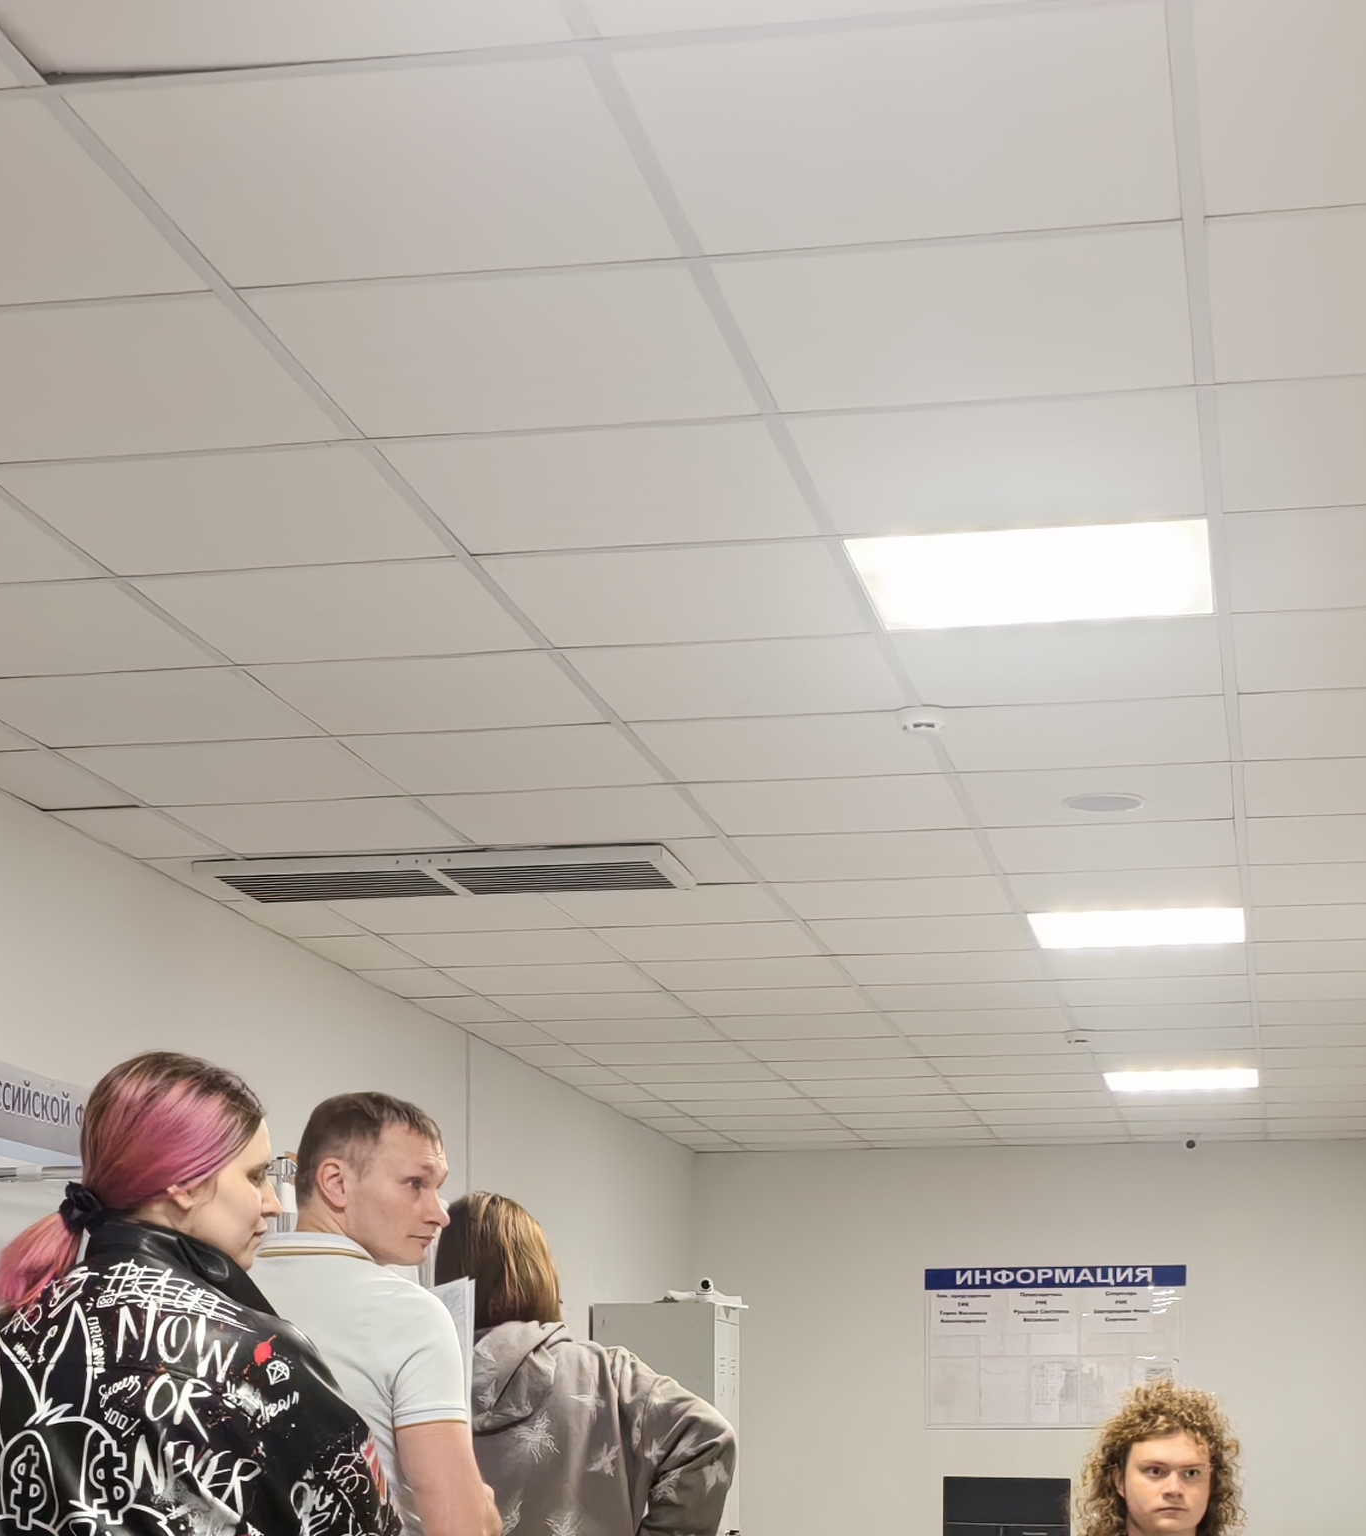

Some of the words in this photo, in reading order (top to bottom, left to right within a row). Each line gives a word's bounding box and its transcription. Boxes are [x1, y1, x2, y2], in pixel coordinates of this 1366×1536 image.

[955, 1267, 1153, 1286] ИНФОРМАЦИЯ
[116, 1301, 239, 1383] NOW
[145, 1372, 210, 1443] OR
[134, 1430, 262, 1516] NEVER
